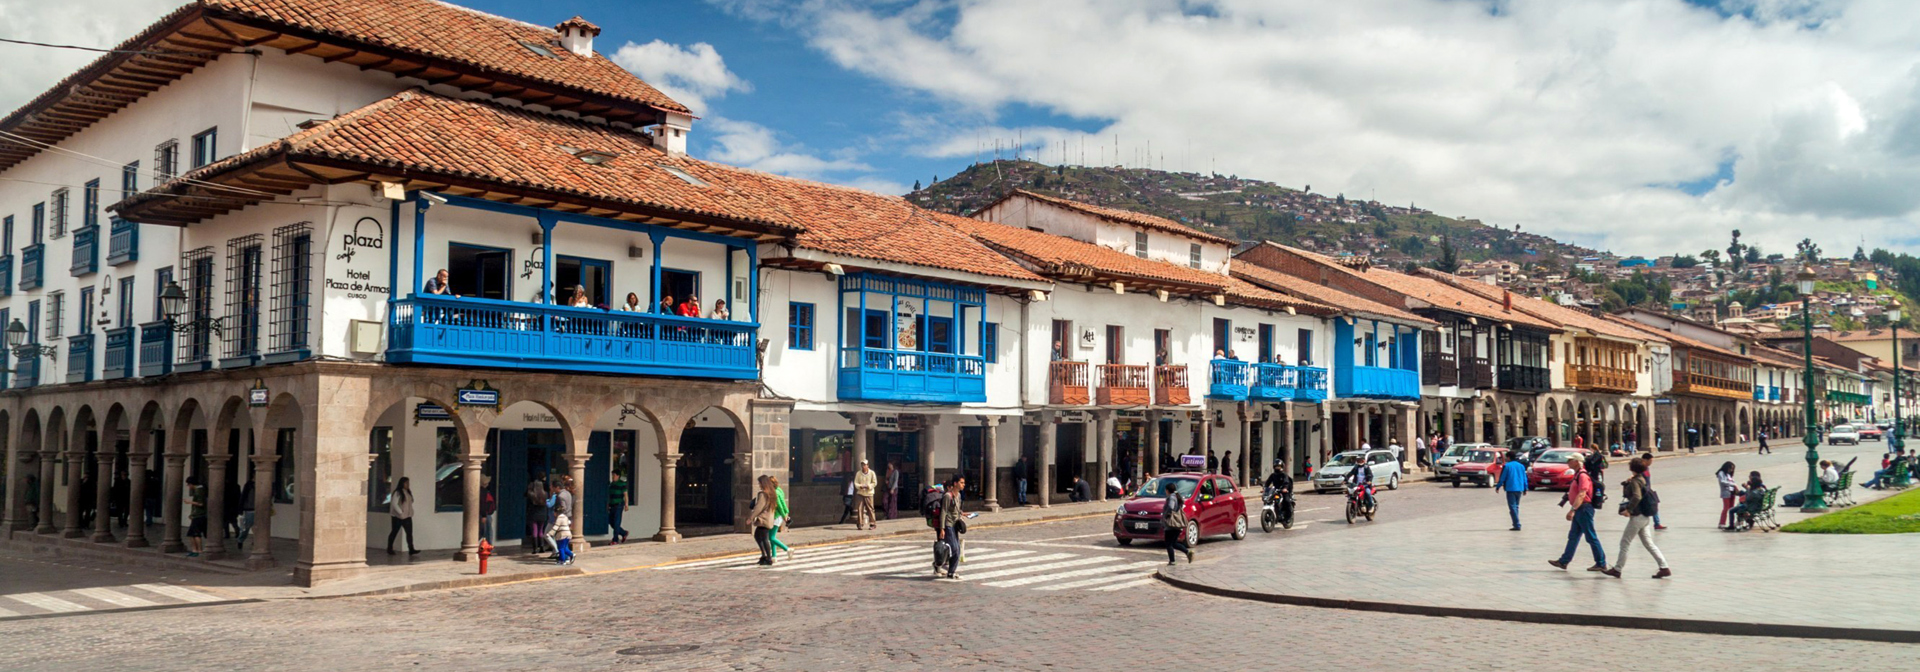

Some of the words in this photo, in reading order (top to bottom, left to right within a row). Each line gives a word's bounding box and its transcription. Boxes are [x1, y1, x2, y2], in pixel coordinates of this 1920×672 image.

[343, 226, 383, 249] plaza
[336, 246, 356, 263] café
[524, 254, 544, 272] plaz
[346, 269, 370, 280] Hotel
[325, 278, 349, 290] Plaza
[350, 281, 363, 291] de
[364, 283, 390, 294] Armas
[523, 413, 540, 422] Hotel
[1182, 457, 1205, 465] Latino
